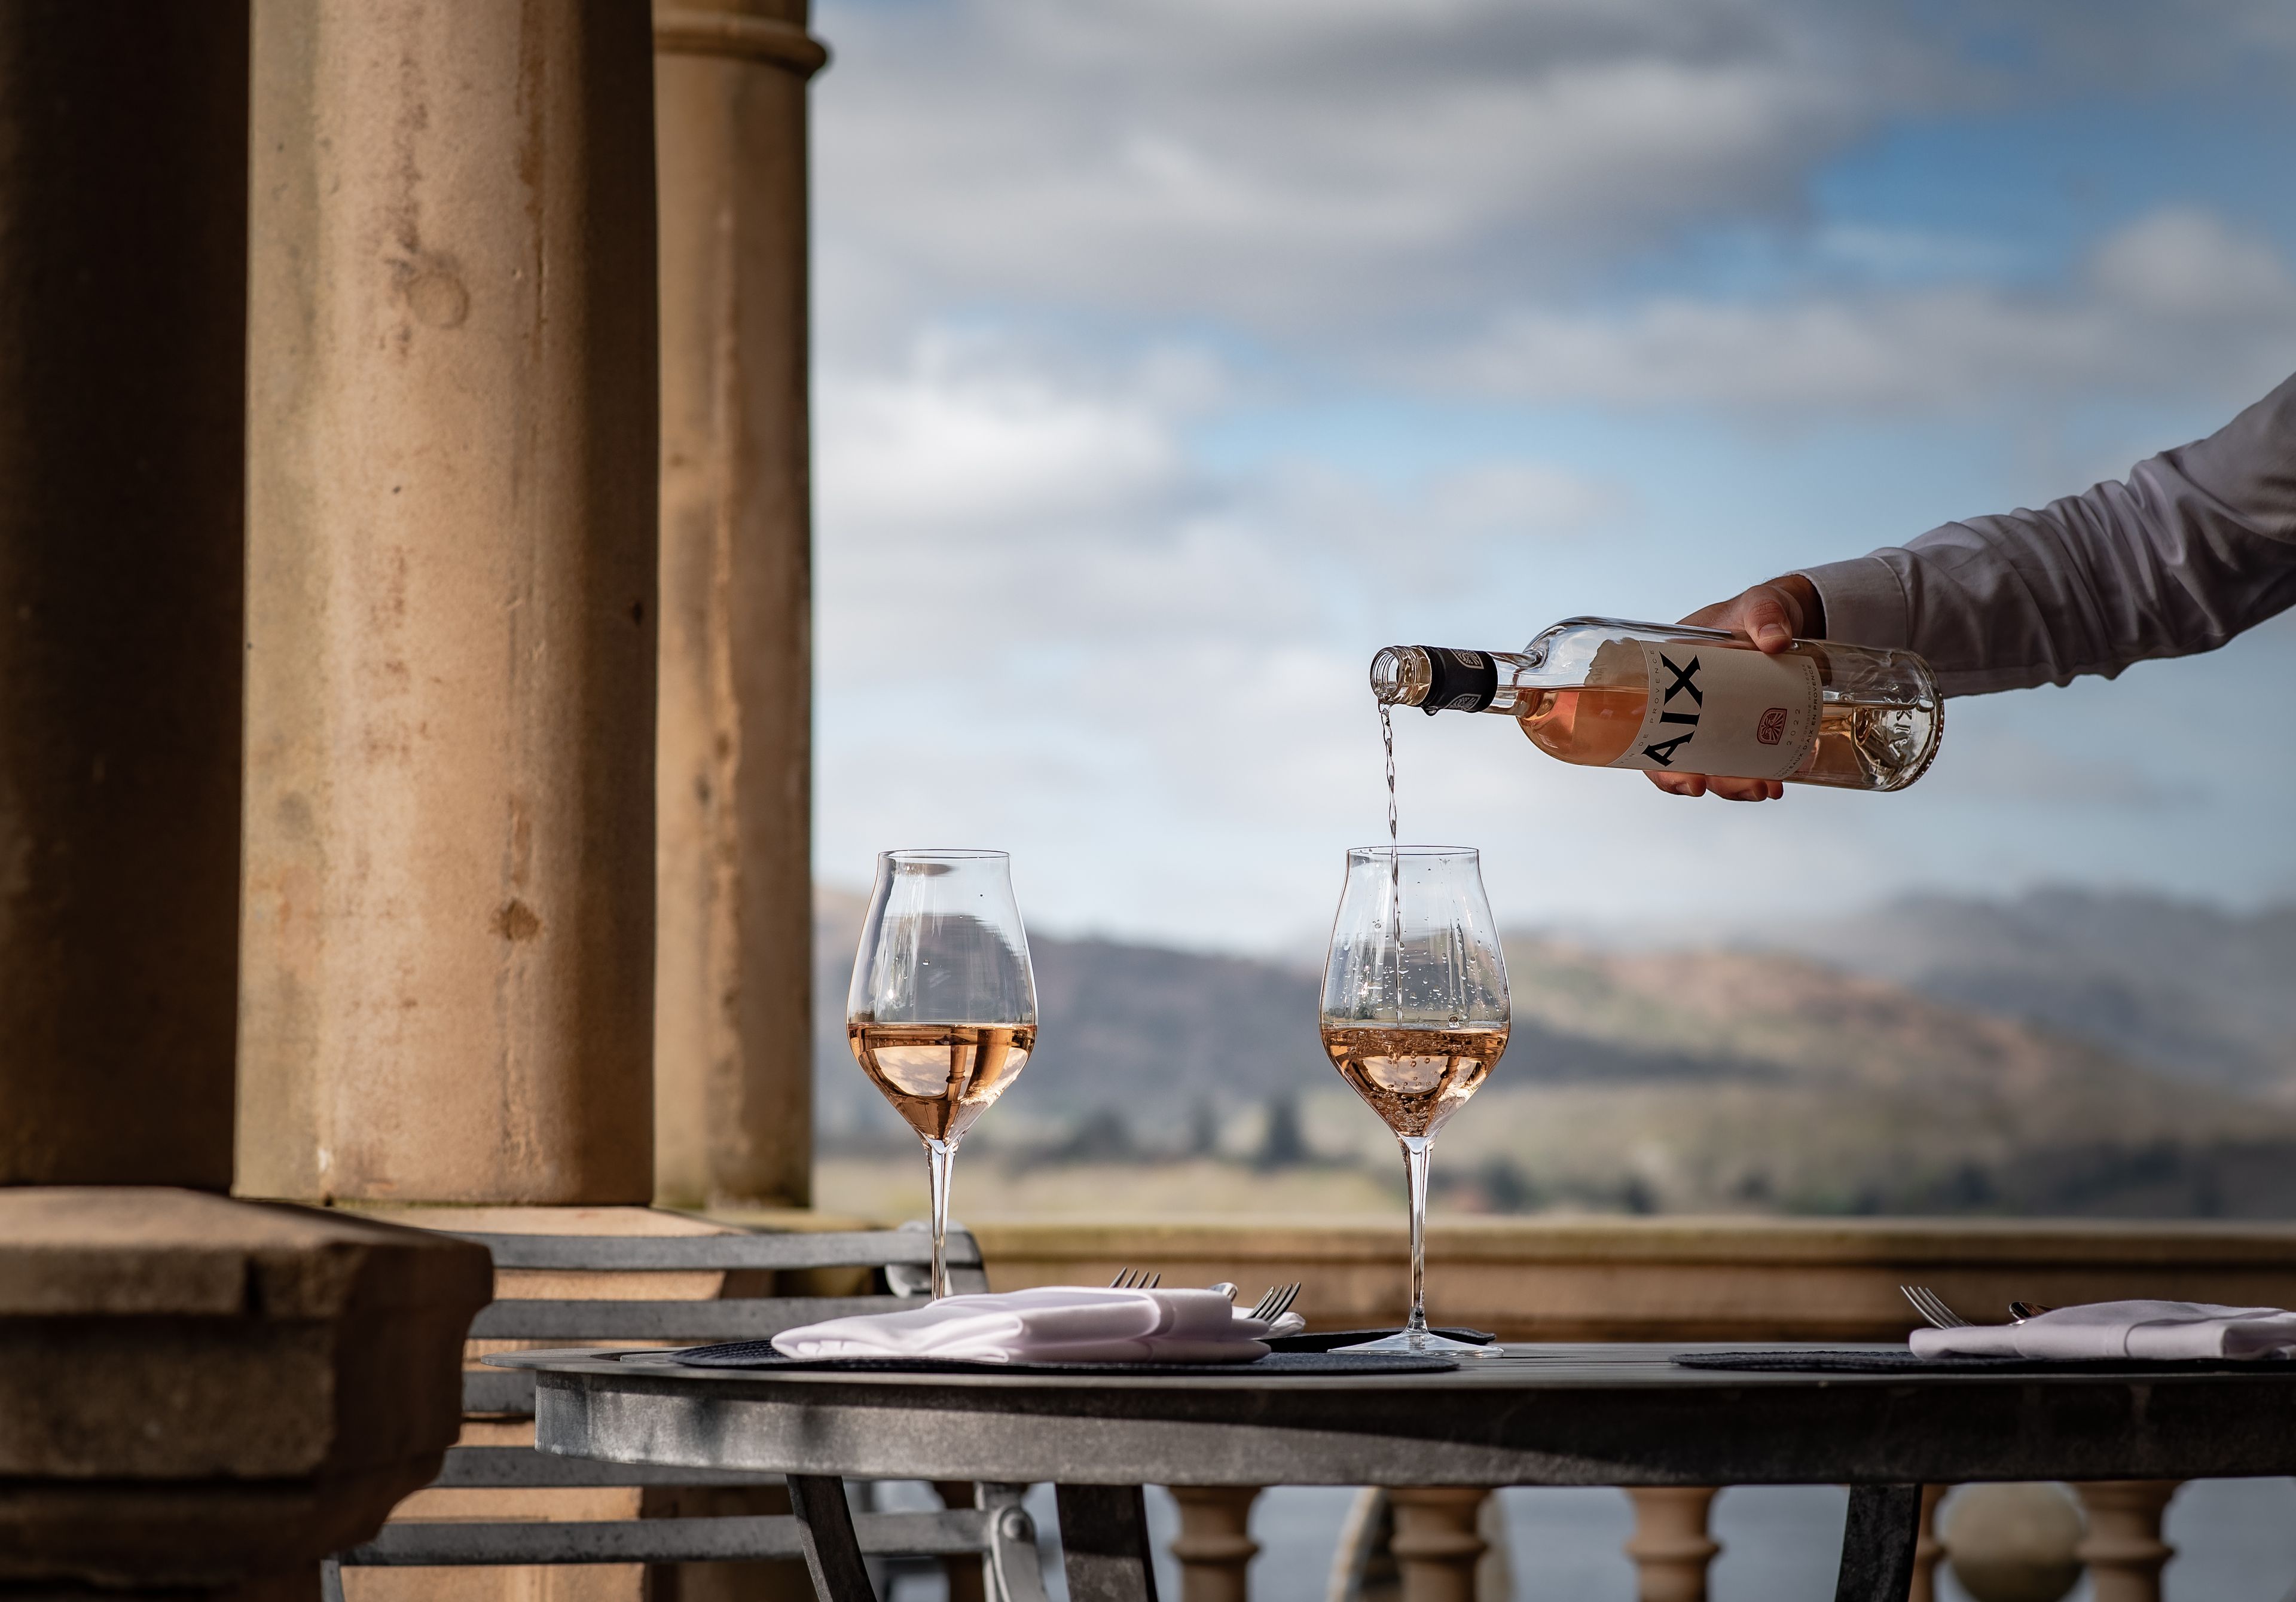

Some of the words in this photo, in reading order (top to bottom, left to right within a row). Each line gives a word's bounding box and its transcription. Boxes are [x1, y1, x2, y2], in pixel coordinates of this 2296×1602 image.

[1638, 733, 1648, 746] DE
[1650, 649, 1660, 723] PROVENCE
[1807, 664, 1818, 710] PROVENCE
[1641, 651, 1703, 767] AIX
[1787, 708, 1801, 746] 2022
[1811, 714, 1817, 726] EN
[1803, 729, 1814, 750] D'AIX
